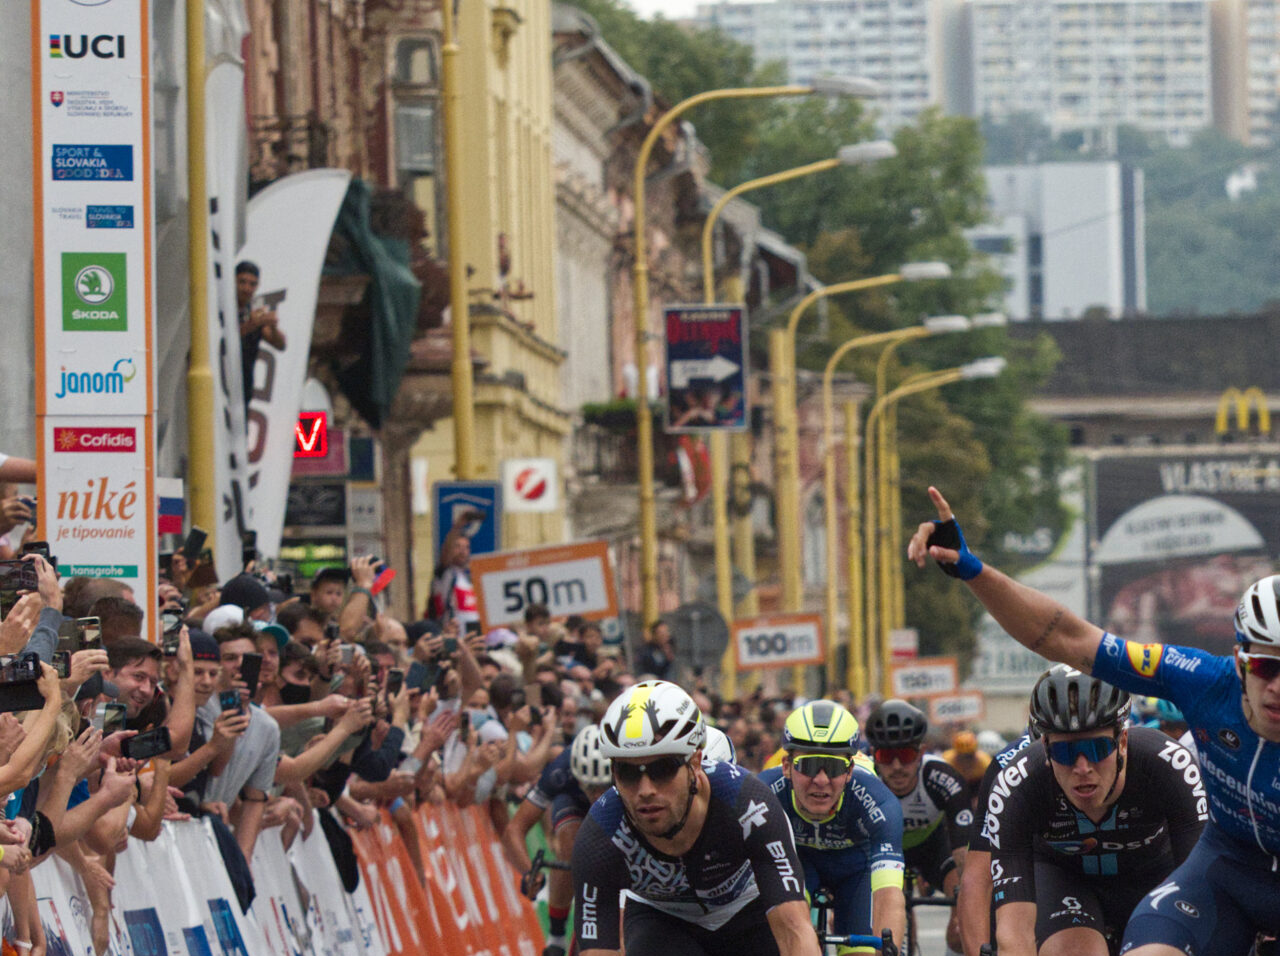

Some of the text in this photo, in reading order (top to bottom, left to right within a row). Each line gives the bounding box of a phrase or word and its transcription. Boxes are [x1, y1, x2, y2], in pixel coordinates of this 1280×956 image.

[63, 34, 126, 59] UCI
[55, 147, 89, 158] SPORT
[55, 158, 108, 168] SLOVAKIA
[71, 308, 119, 320] ŠKODA
[55, 365, 124, 399] janom
[80, 432, 134, 448] Cofidis
[56, 477, 138, 521] niké
[57, 525, 136, 542] je tipovanie
[70, 565, 125, 579] hansgrohe
[503, 576, 588, 614] 50m
[743, 631, 817, 657] 100m
[929, 768, 962, 797] KERN
[986, 756, 1029, 850] zoover
[1101, 826, 1164, 851] DSM
[766, 840, 801, 894] BMC
[581, 882, 598, 940] BMC
